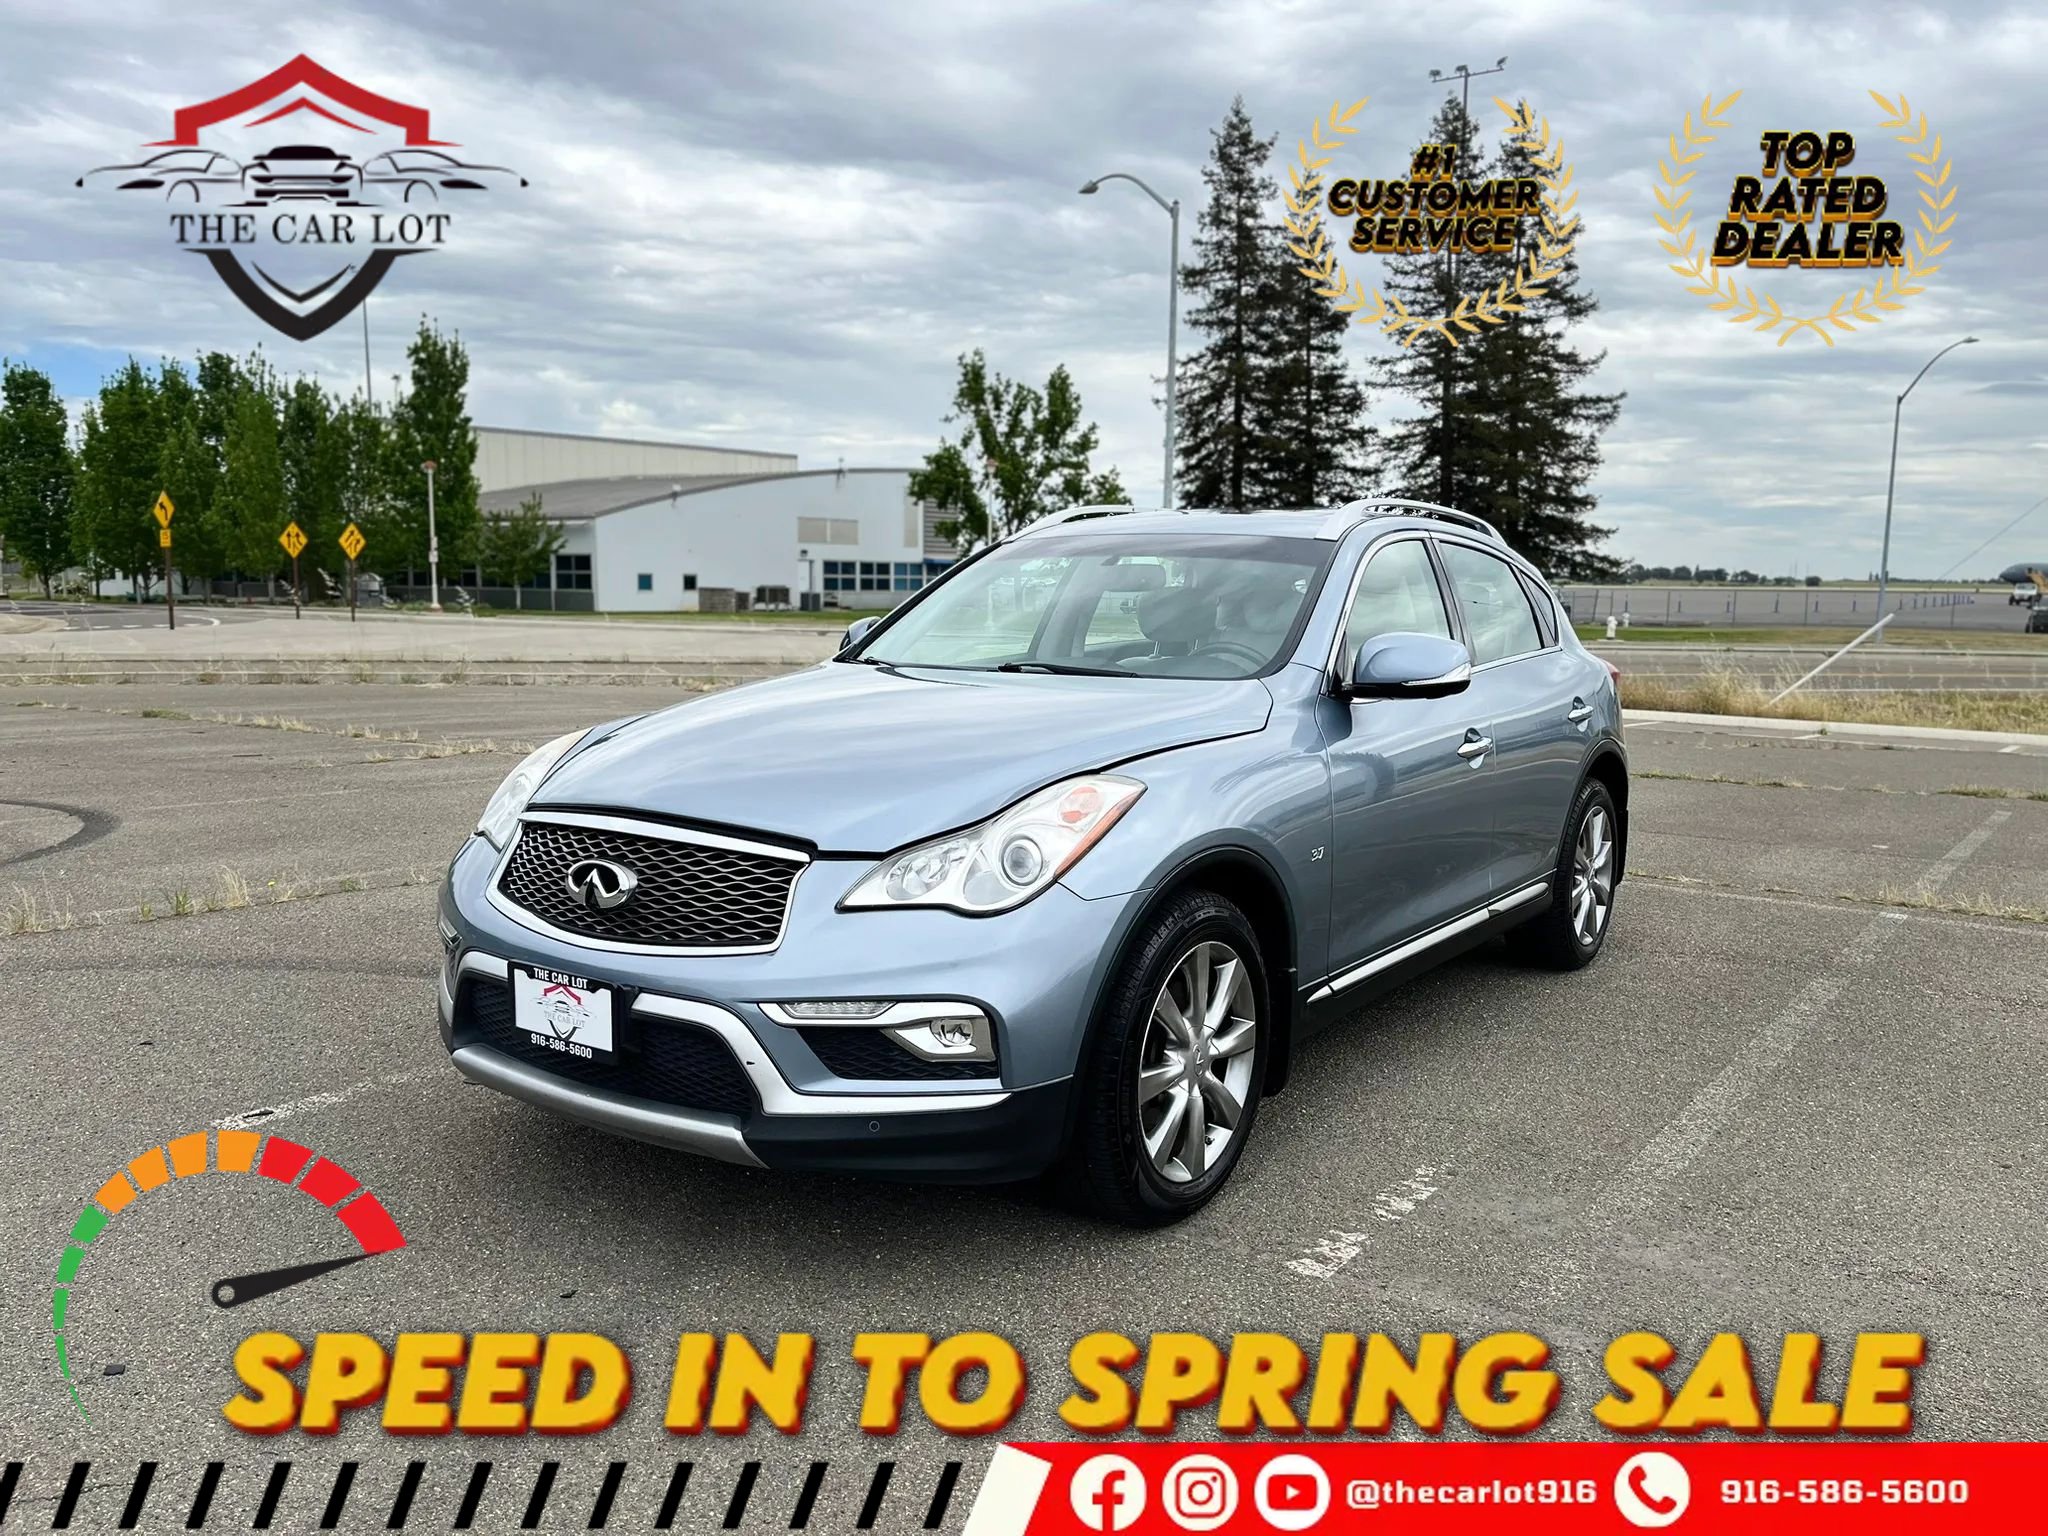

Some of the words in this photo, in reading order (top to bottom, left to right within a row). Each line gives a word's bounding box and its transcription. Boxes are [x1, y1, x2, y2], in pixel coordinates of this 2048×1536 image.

[533, 967, 550, 981] THE
[551, 971, 570, 986] CAR
[571, 976, 588, 990] LOT
[557, 1013, 571, 1024] CAR
[572, 1017, 586, 1028] LOT
[531, 1034, 592, 1058] 916-586-5600
